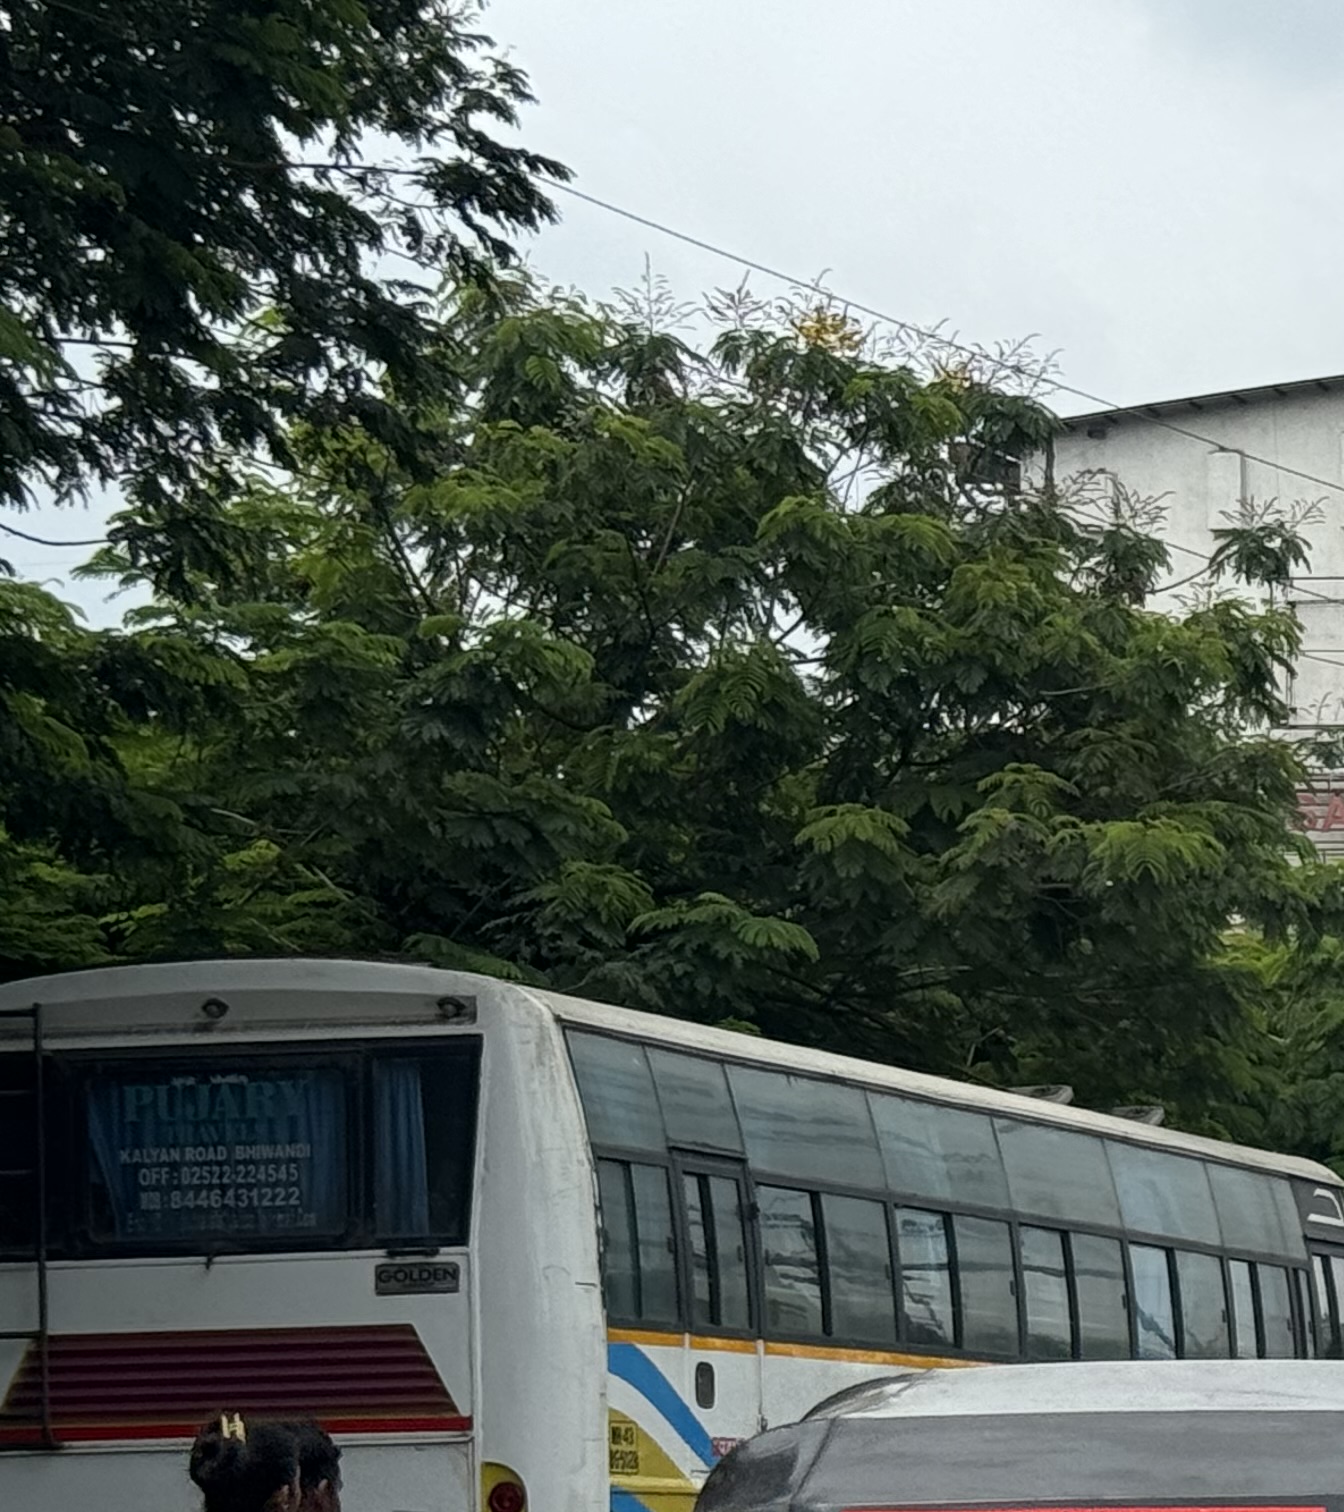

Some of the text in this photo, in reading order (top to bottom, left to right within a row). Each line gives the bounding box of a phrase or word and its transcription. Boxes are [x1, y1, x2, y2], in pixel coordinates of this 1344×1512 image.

[120, 1143, 312, 1164] KALYAN ROAD BHIWANDI
[171, 1187, 301, 1209] 8446431222
[379, 1268, 457, 1284] GOLDEN
